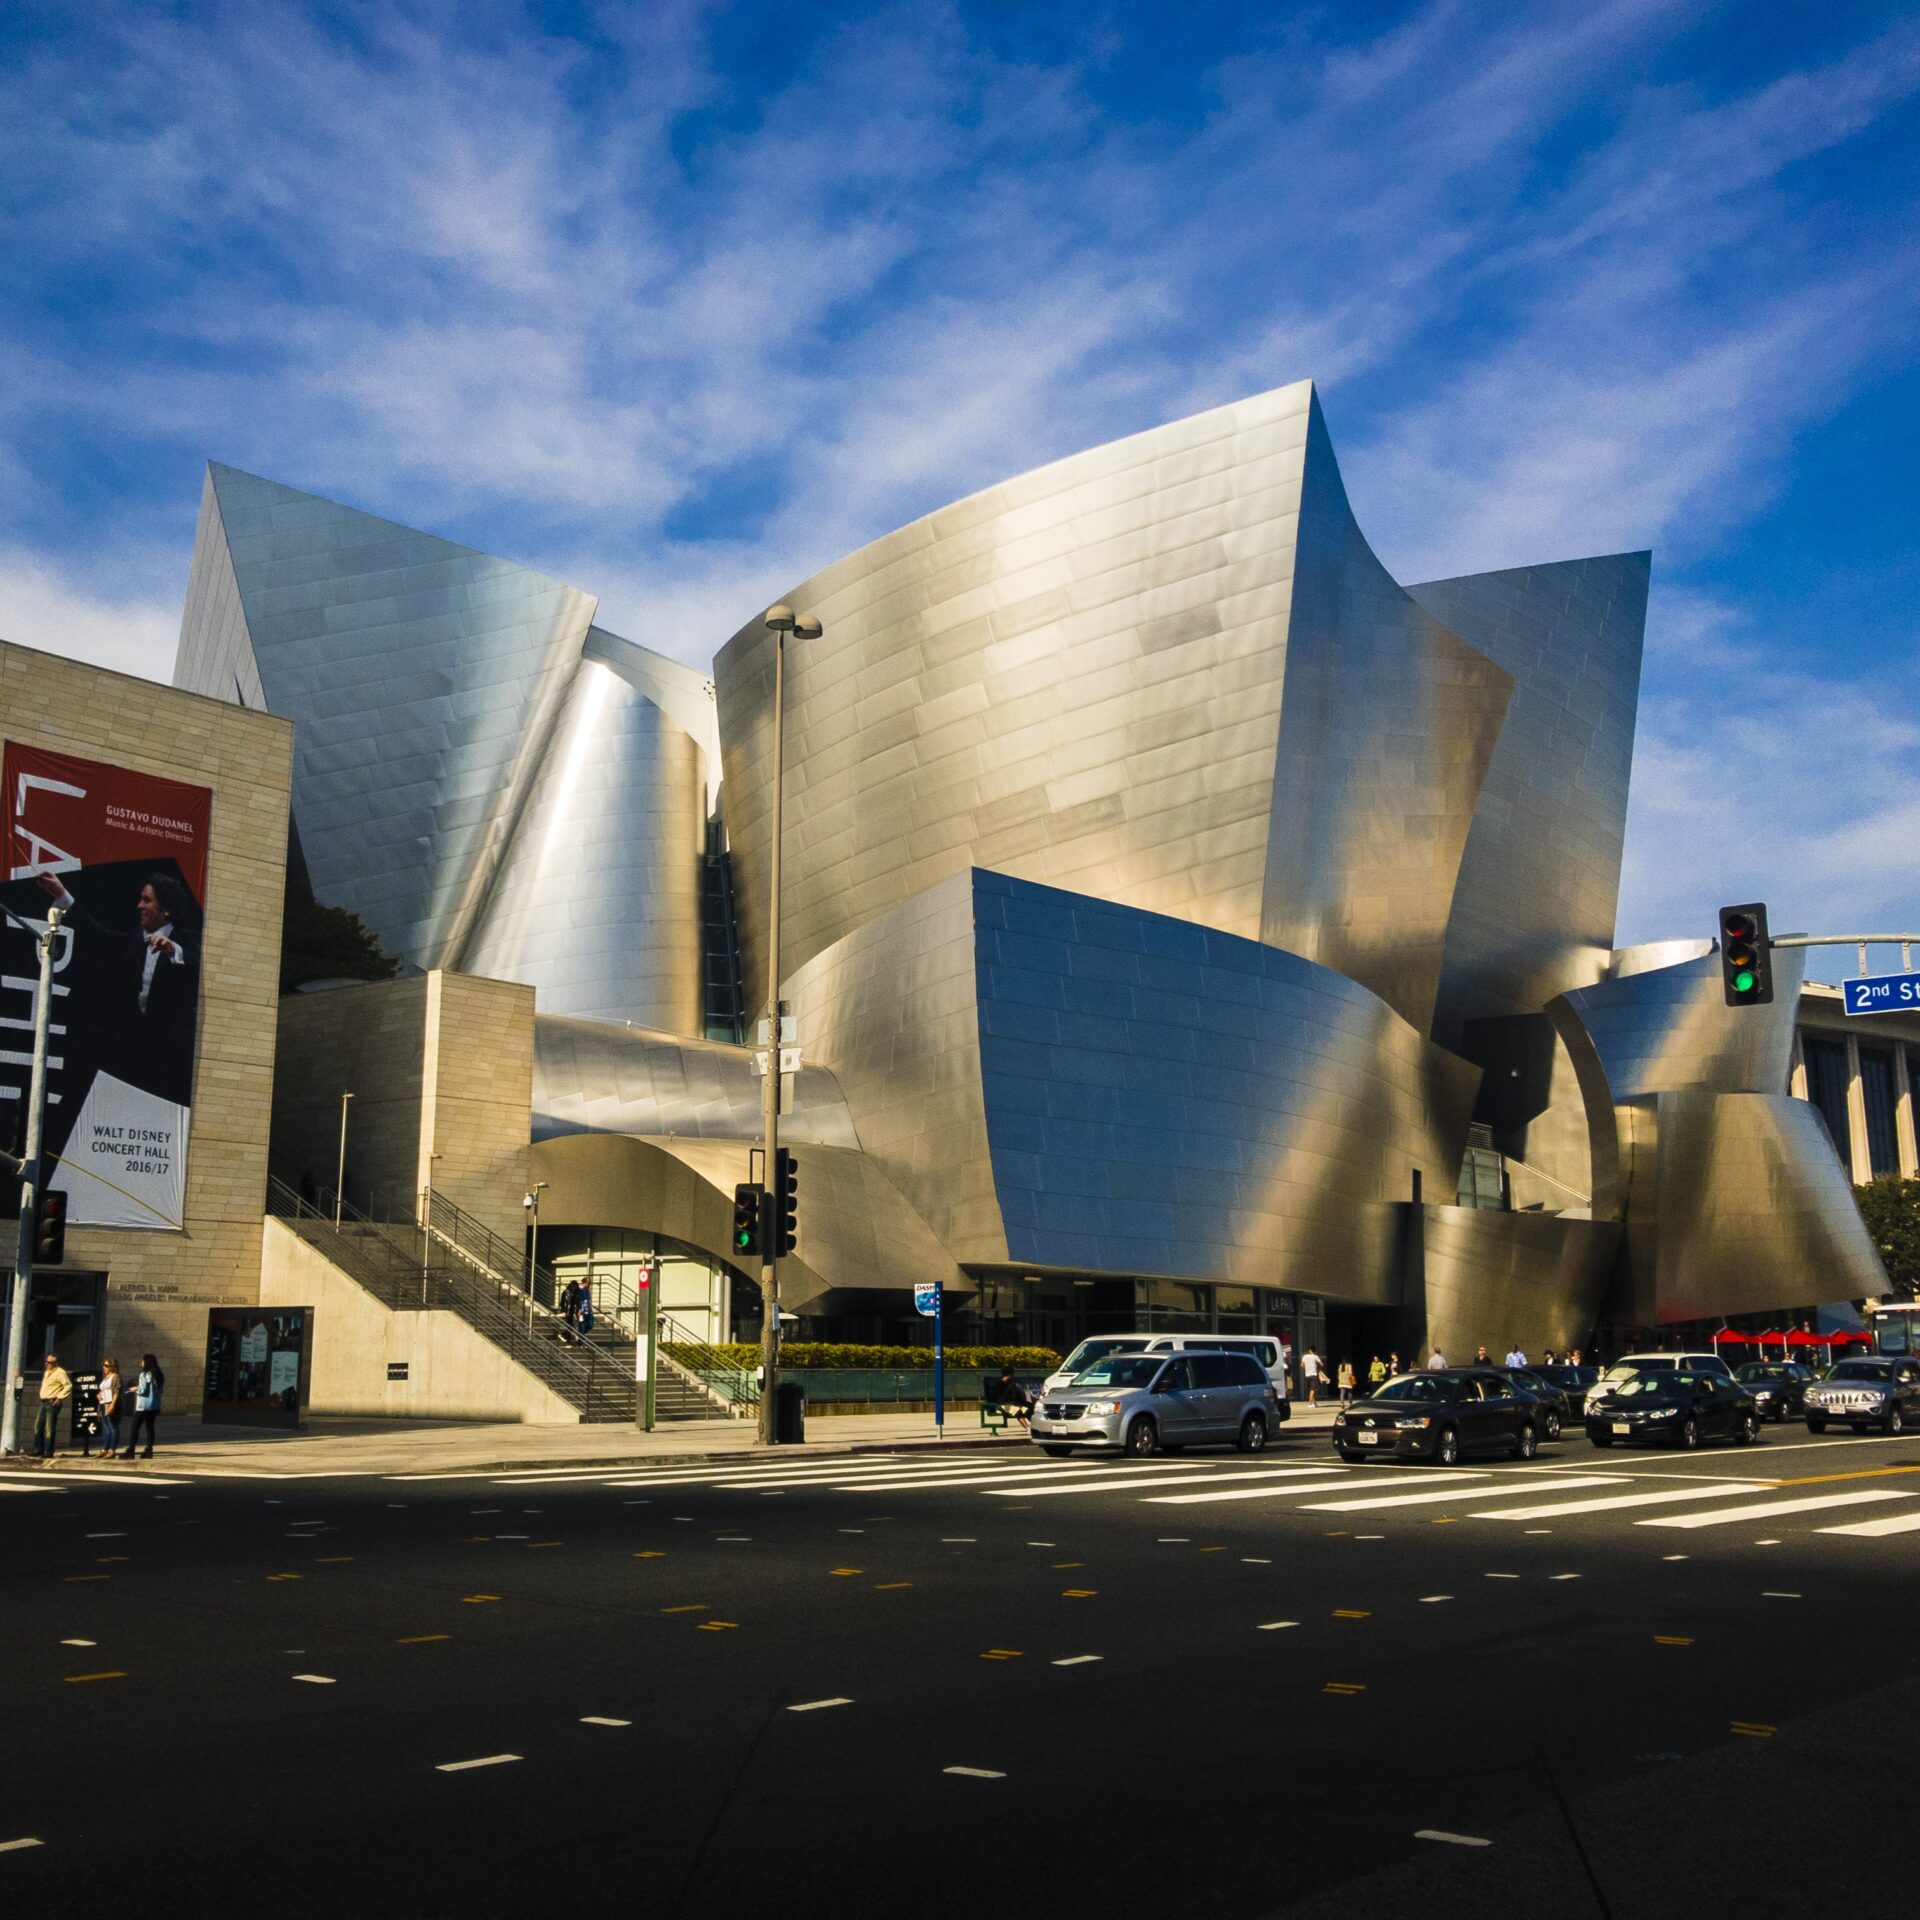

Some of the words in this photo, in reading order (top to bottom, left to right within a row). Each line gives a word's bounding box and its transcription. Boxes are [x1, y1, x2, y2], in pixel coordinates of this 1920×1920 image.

[10, 772, 87, 880] LA
[105, 817, 128, 830] Music
[129, 822, 136, 831] &
[136, 824, 164, 838] Artistic
[165, 830, 194, 843] Director
[106, 805, 150, 823] GUSTAVO
[151, 815, 194, 833] DUDAMEL
[1856, 984, 1890, 1006] 2nd
[93, 1125, 125, 1139] WALT
[128, 1128, 171, 1143] DISNEY
[91, 1141, 142, 1156] CONCERT
[144, 1146, 170, 1159] HALL
[125, 1160, 169, 1175] 2016/17
